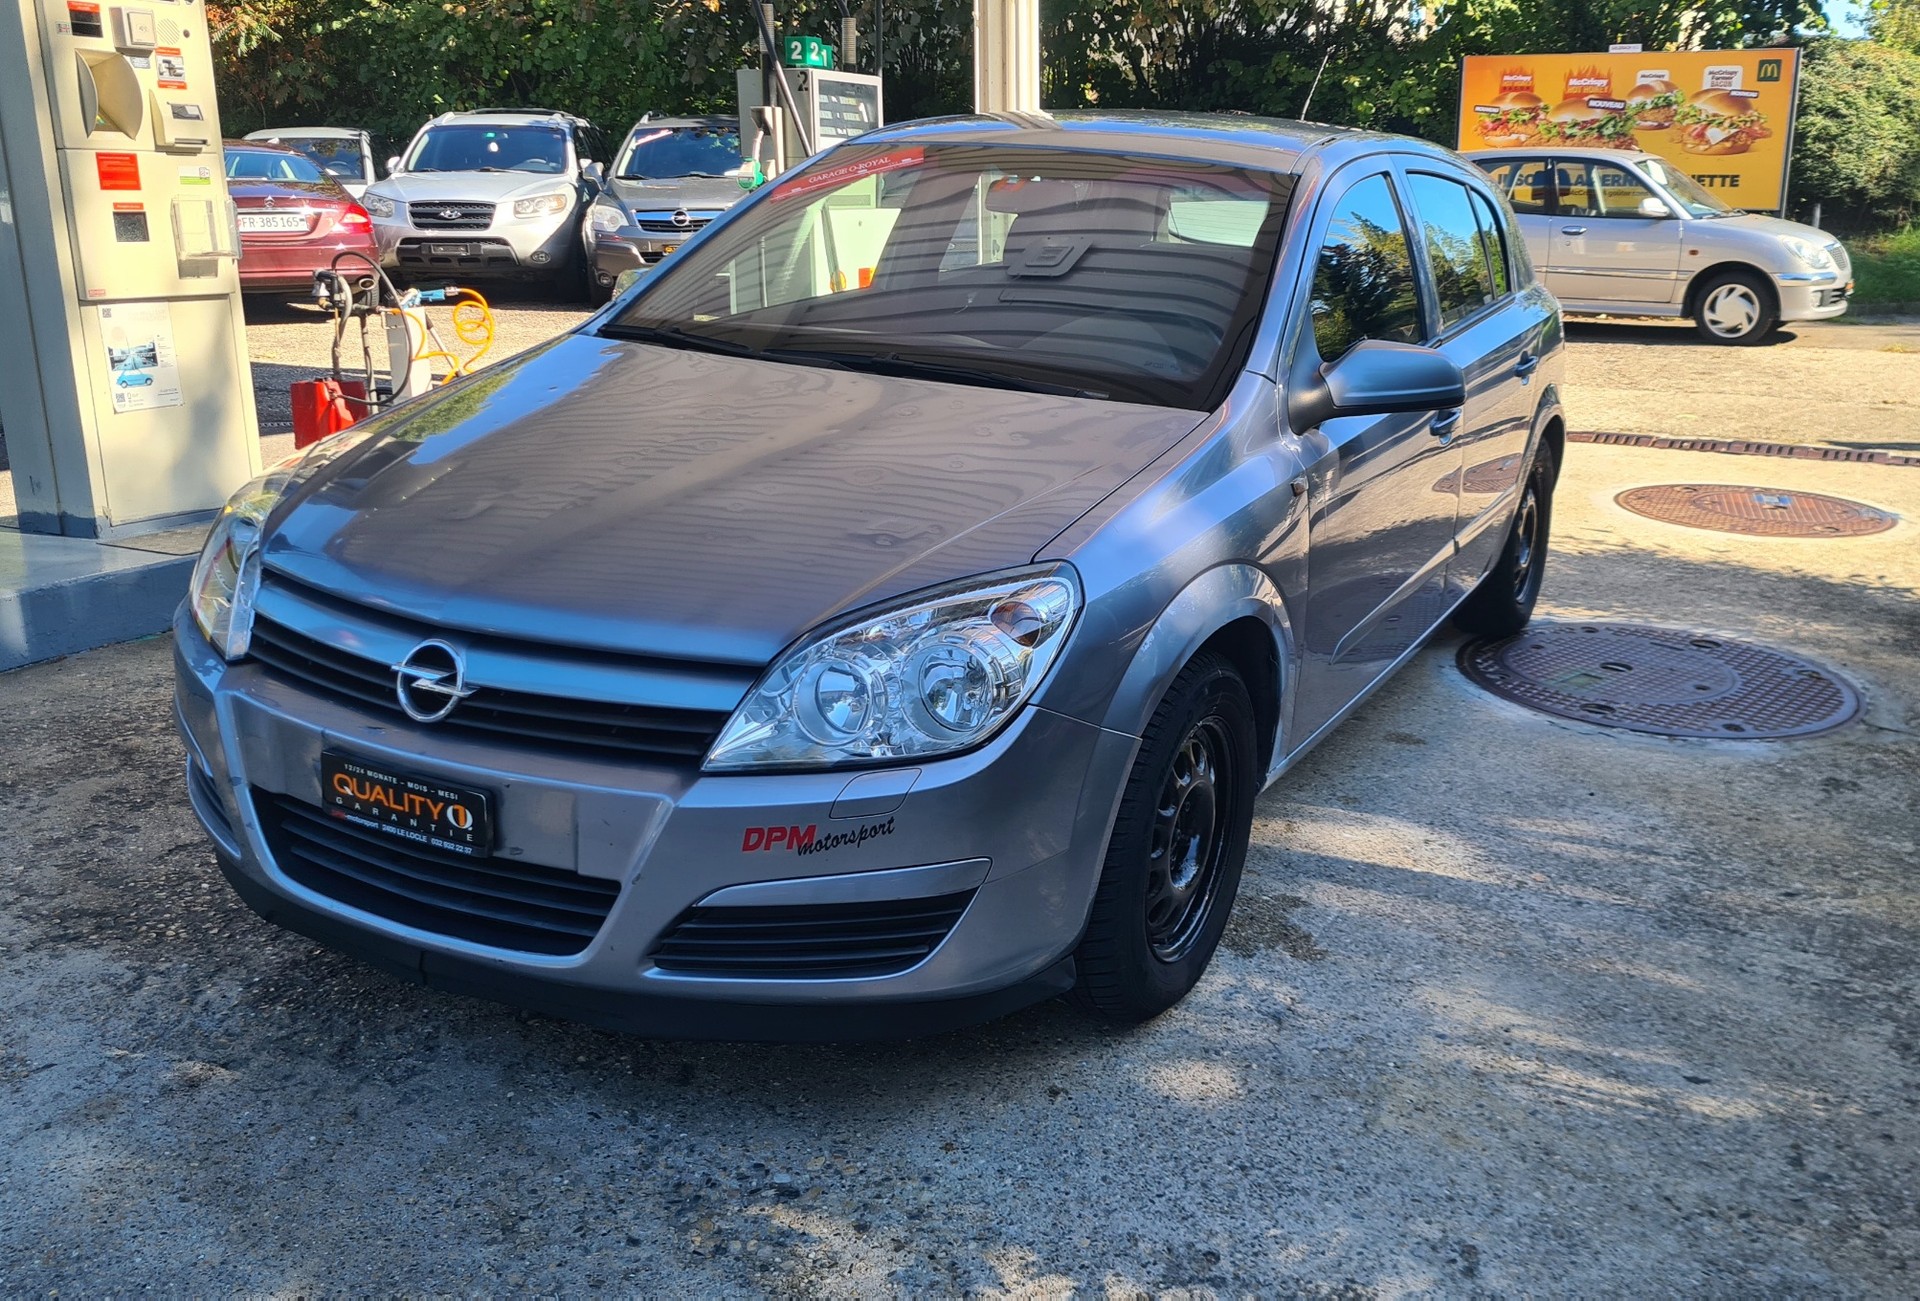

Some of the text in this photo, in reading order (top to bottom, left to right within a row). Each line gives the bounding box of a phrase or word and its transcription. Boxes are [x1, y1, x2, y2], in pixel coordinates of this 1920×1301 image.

[791, 41, 802, 60] 2
[810, 42, 819, 60] 2
[797, 71, 809, 91] 2
[367, 770, 398, 784] MONATE
[407, 782, 428, 793] MOIS
[333, 773, 444, 820] QUALITY
[406, 830, 428, 843] LOCLE
[741, 824, 817, 852] DPM
